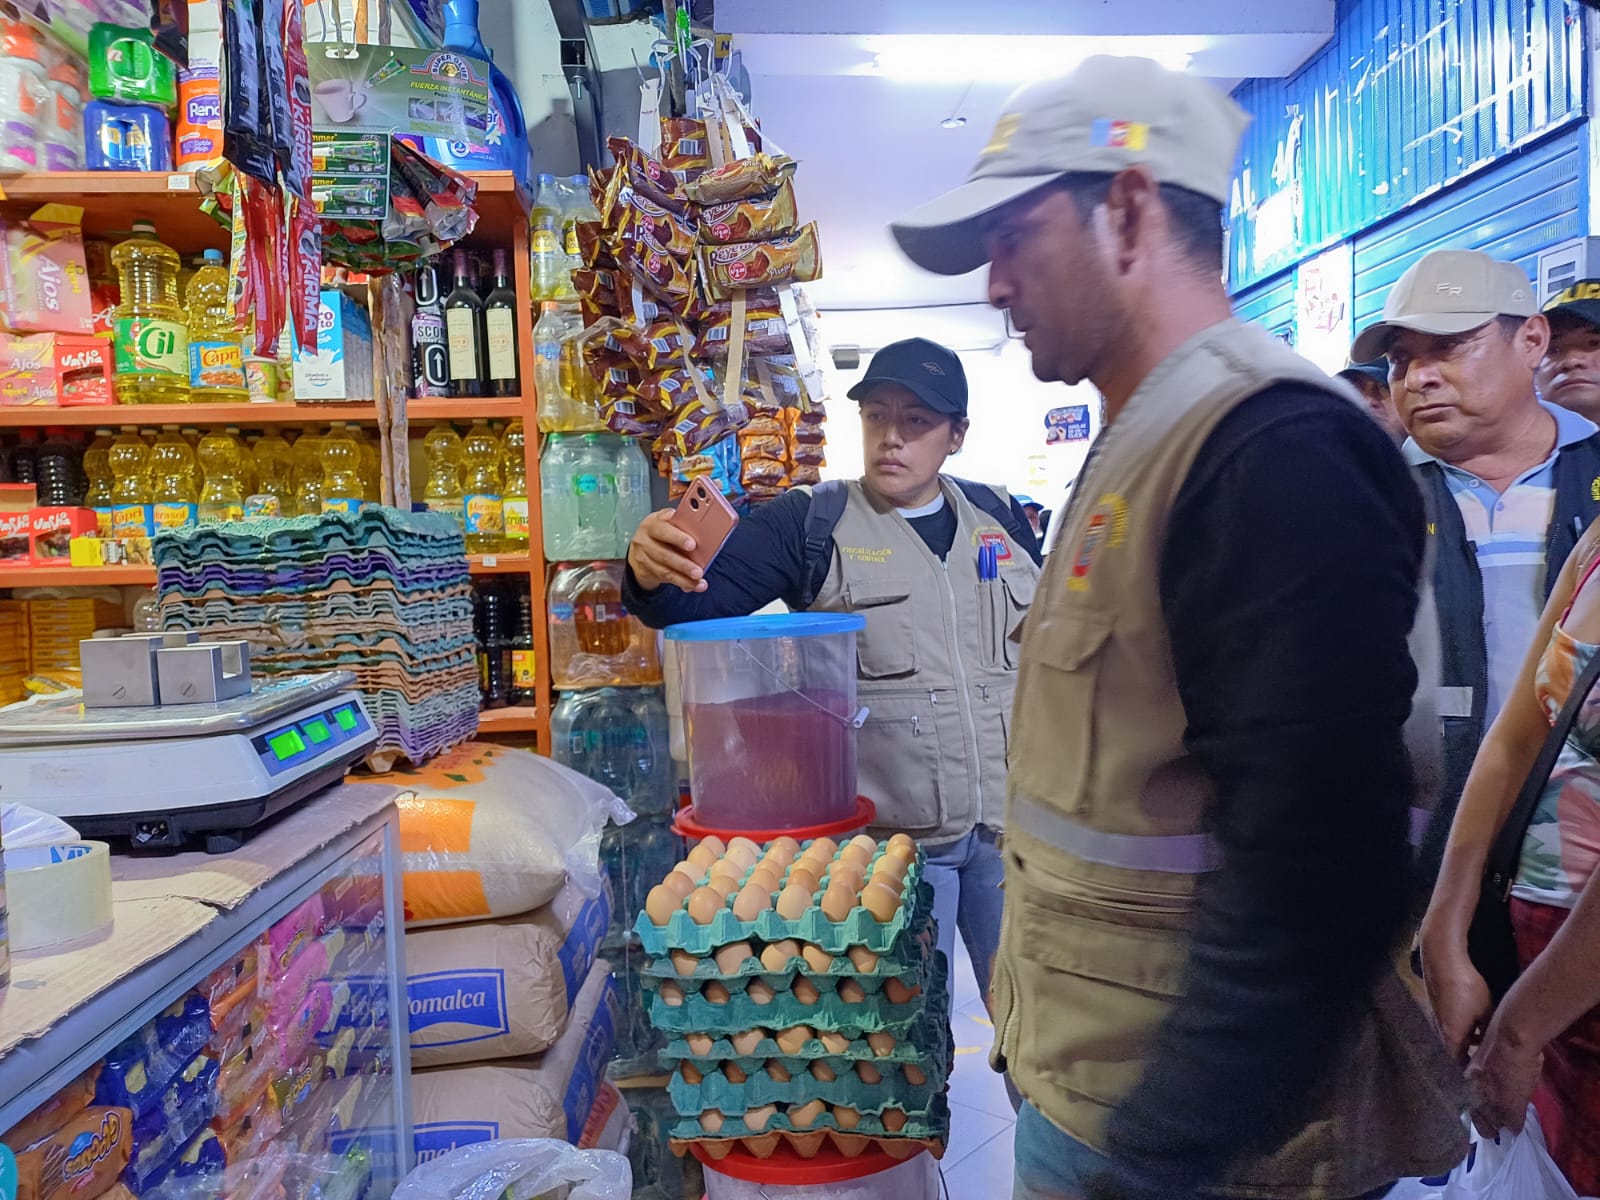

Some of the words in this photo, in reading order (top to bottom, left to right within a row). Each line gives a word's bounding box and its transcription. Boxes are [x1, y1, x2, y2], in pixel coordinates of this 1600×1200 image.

[432, 54, 452, 73] SUPER
[410, 81, 439, 91] FUERZA
[38, 254, 61, 312] Ajos
[301, 258, 321, 333] KIRMA
[417, 325, 442, 338] SCO
[138, 327, 175, 359] Cil
[11, 358, 41, 371] Ajos
[202, 349, 240, 367] Capri
[114, 509, 142, 524] Capri
